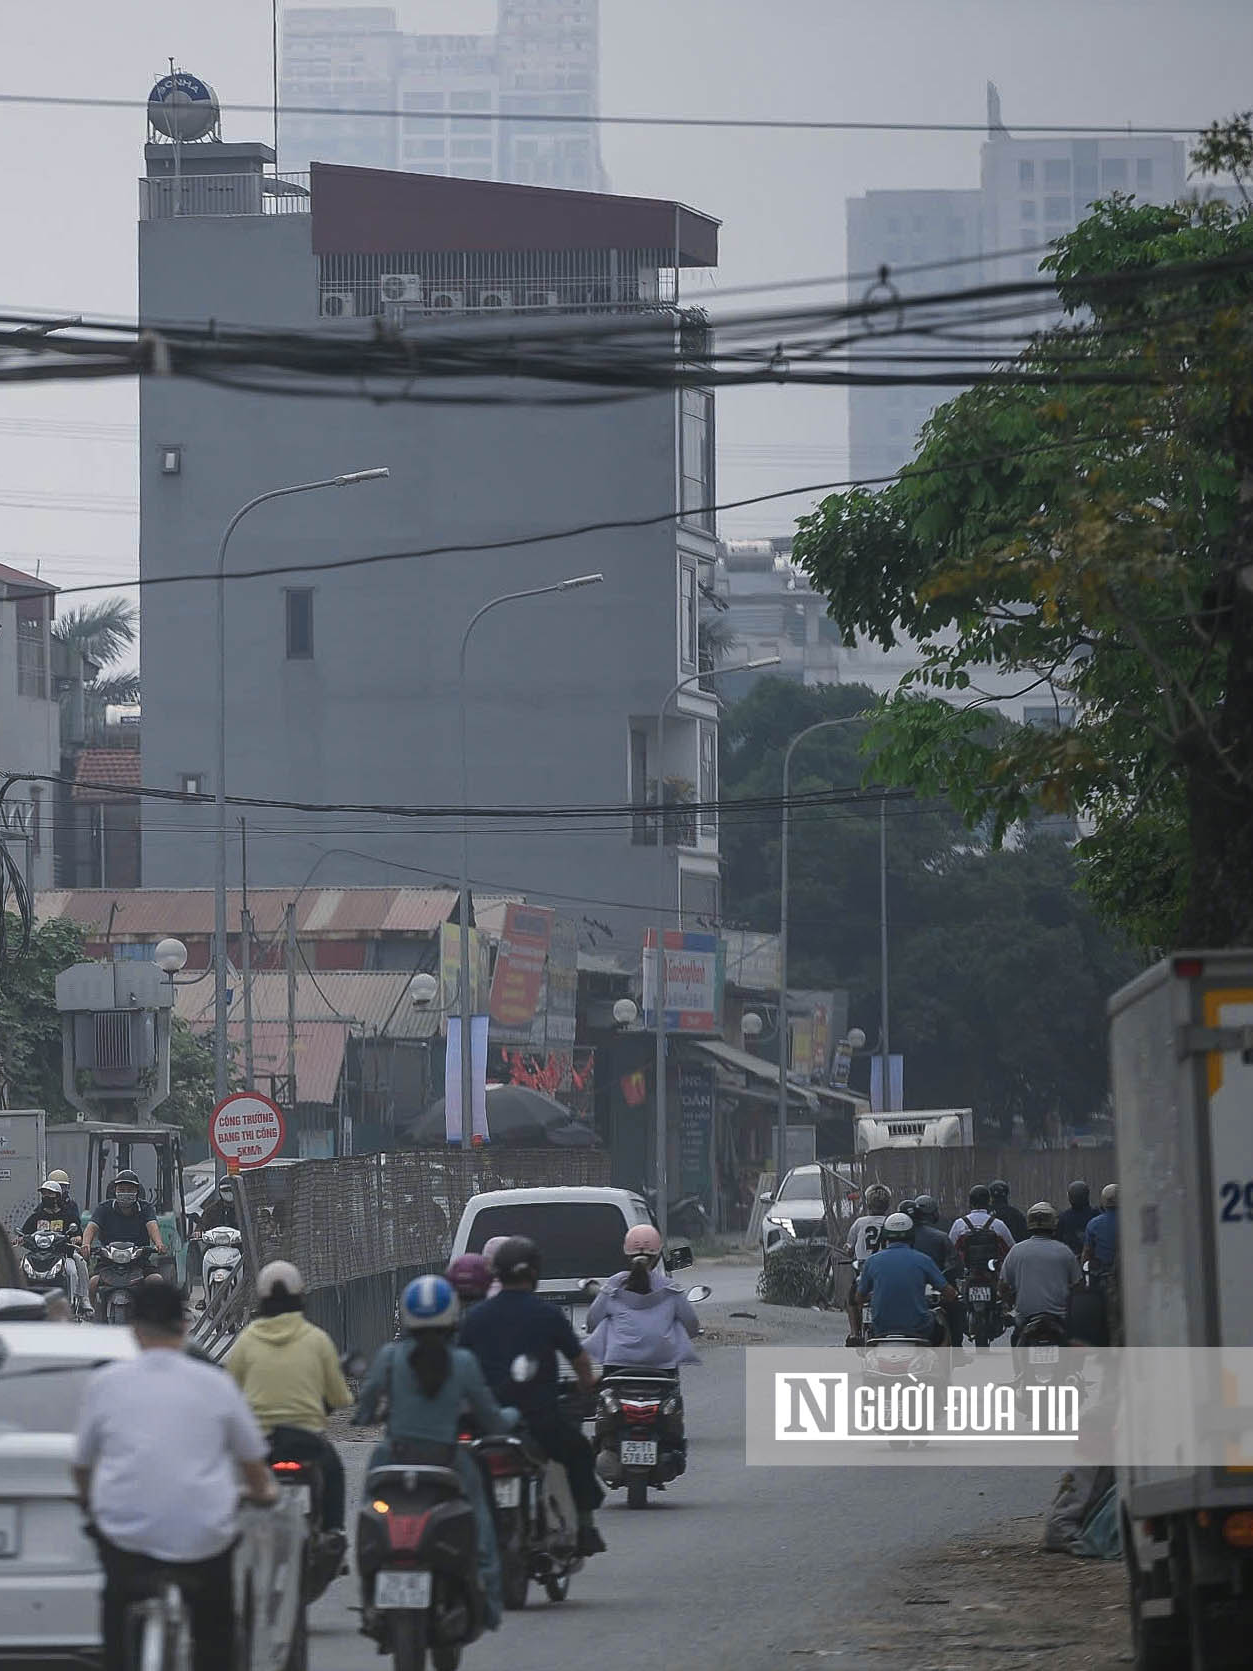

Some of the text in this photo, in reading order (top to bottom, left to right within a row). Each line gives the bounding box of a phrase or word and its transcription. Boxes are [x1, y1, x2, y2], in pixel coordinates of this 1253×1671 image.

[219, 1109, 274, 1127] CÔNG TRƯỜNG
[242, 1129, 254, 1141] THI
[256, 1126, 278, 1139] CÔNG
